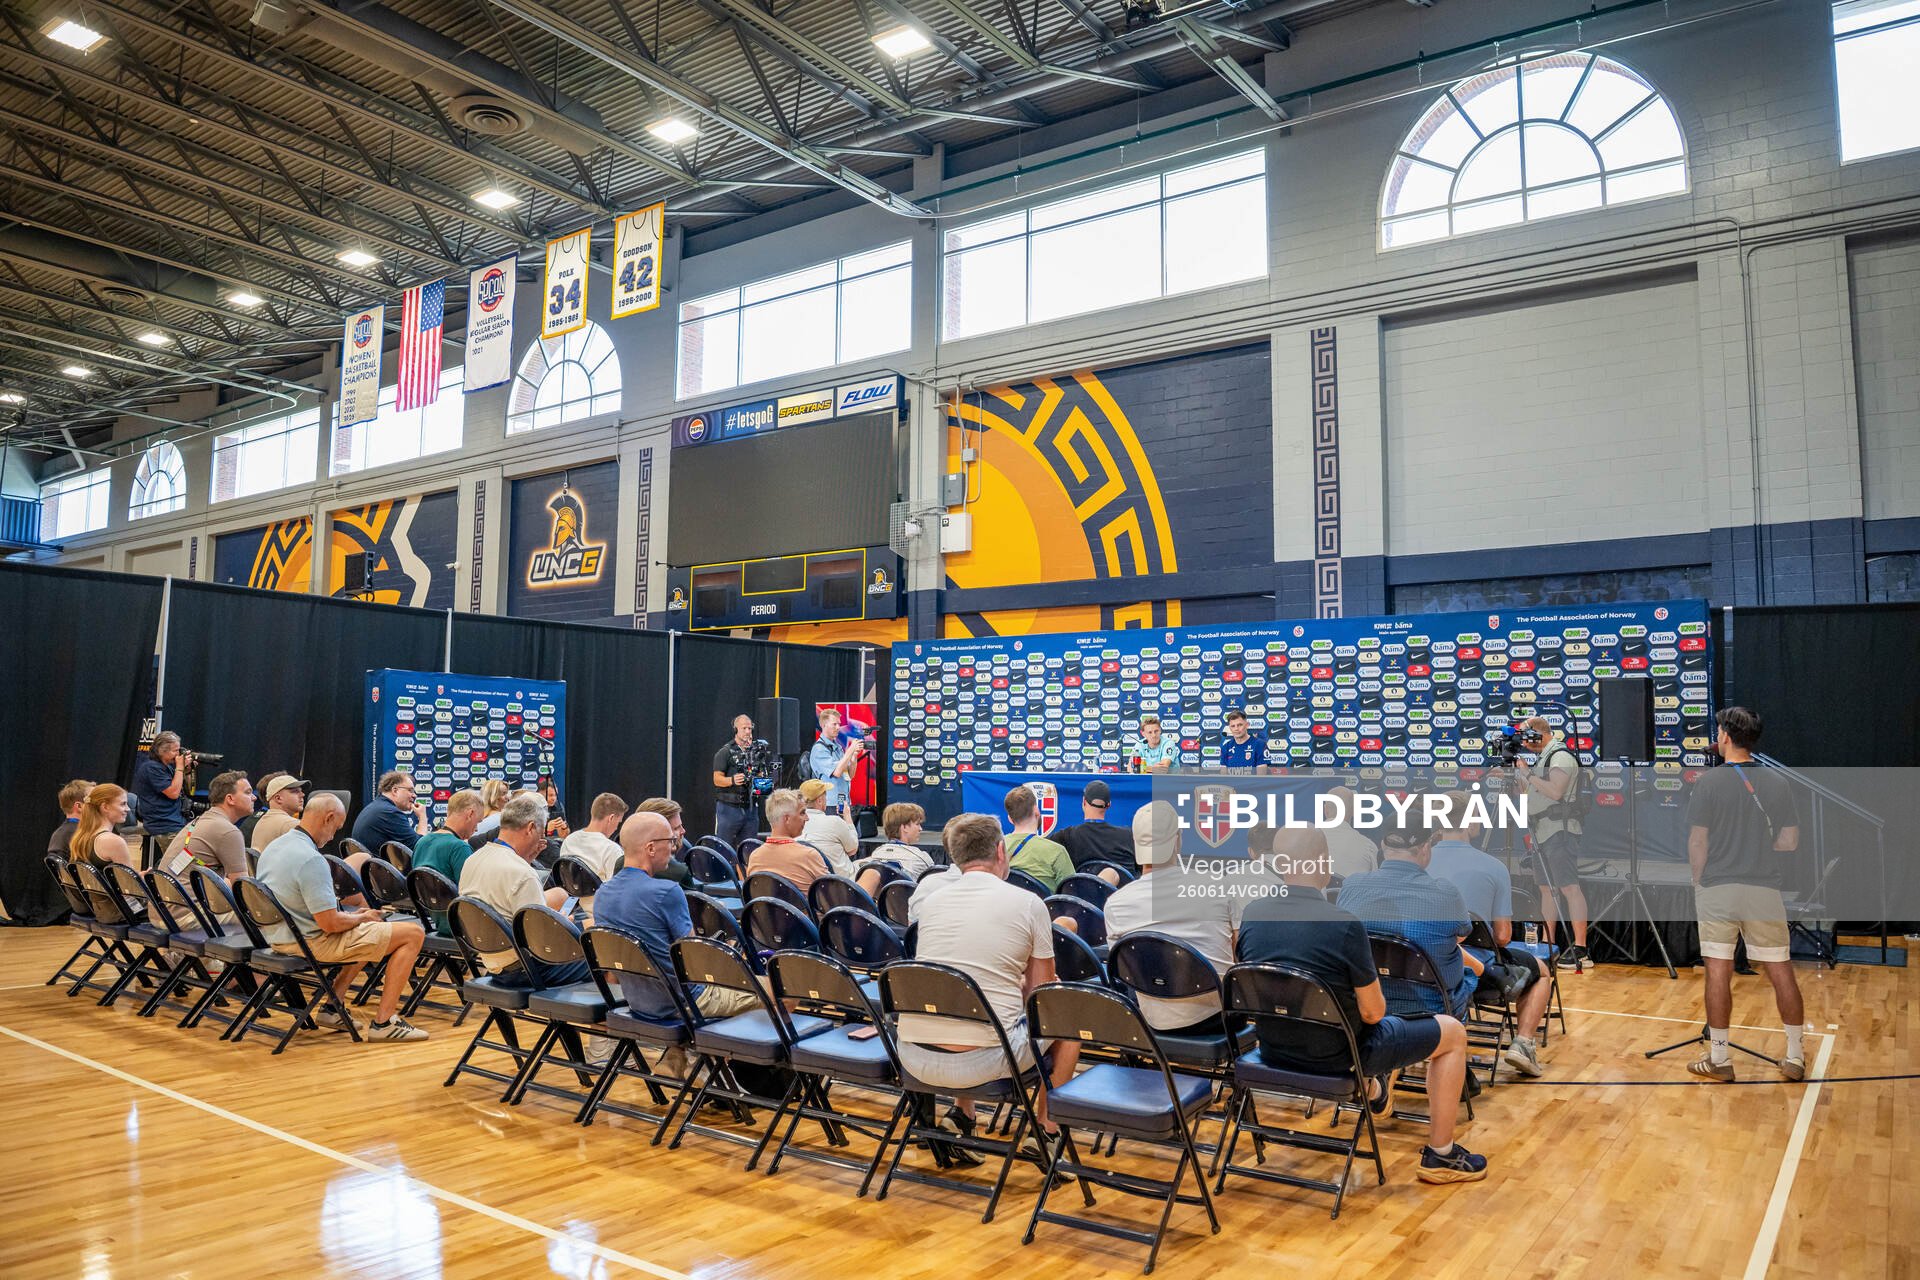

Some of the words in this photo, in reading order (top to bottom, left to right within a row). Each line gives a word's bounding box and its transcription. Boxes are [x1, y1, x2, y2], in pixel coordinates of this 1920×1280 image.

[623, 242, 652, 258] GOODSON
[619, 256, 654, 294] 42
[550, 278, 580, 315] 34
[844, 384, 893, 402] FLOW
[778, 400, 832, 418] SPARTANS
[531, 550, 600, 581] UNCG
[751, 604, 776, 616] PERIOD
